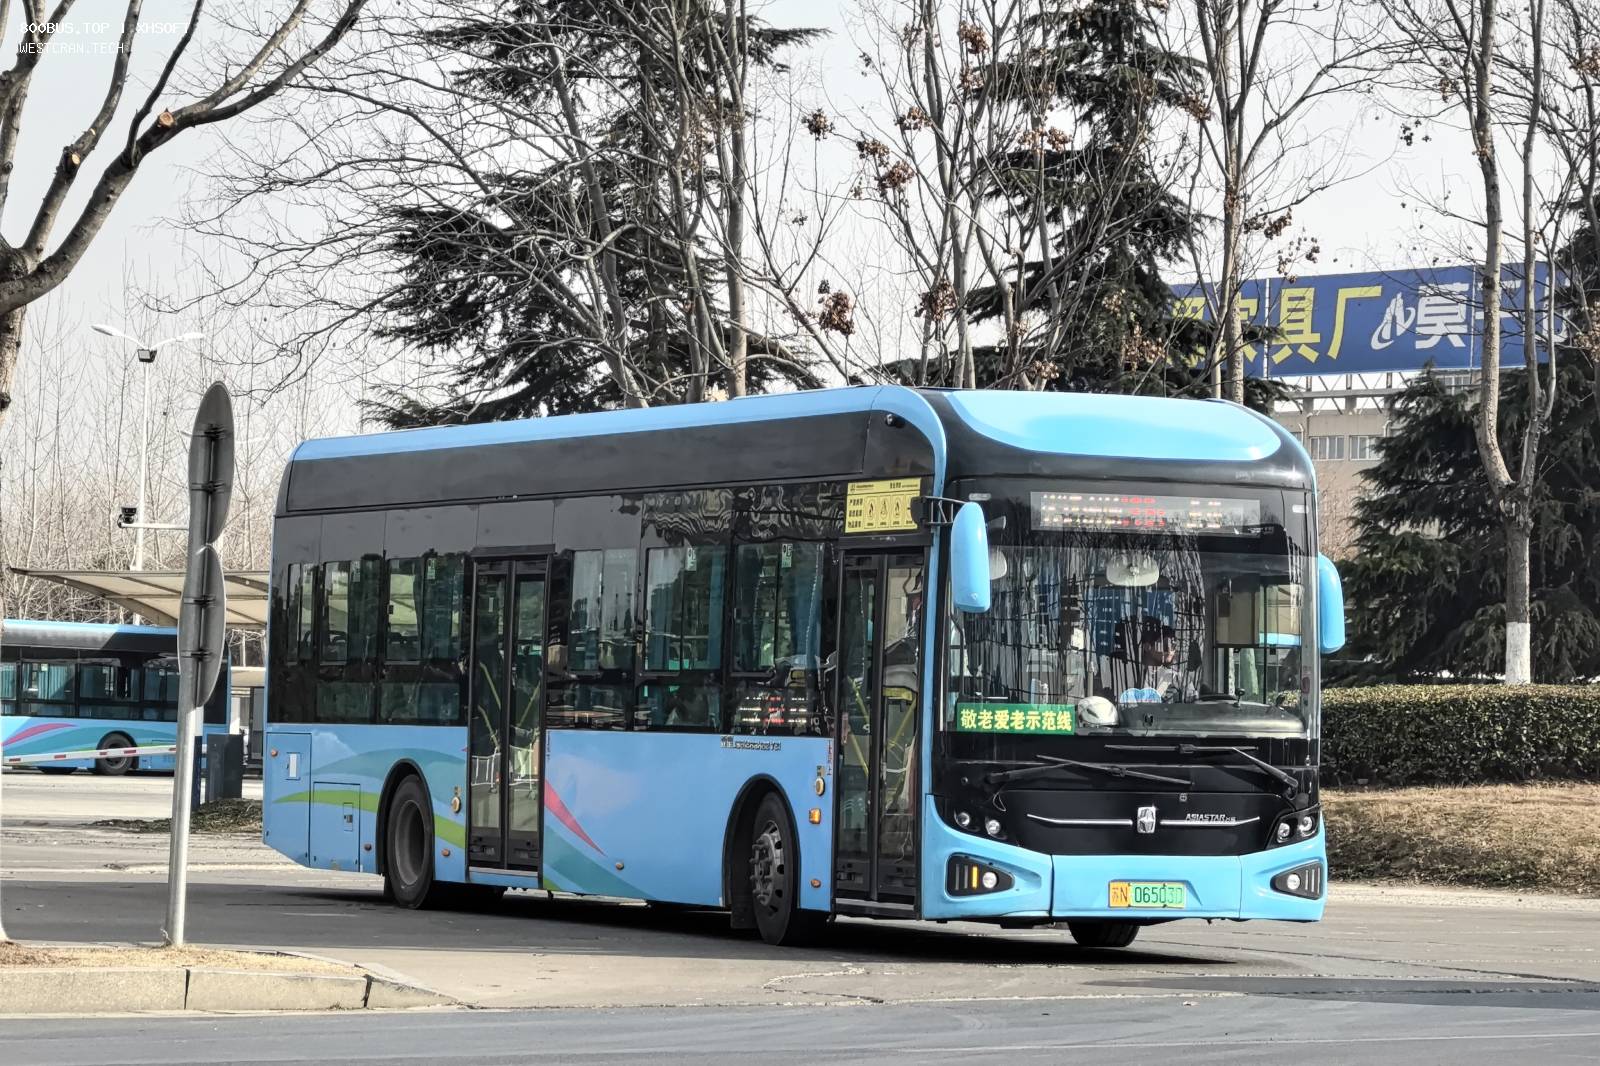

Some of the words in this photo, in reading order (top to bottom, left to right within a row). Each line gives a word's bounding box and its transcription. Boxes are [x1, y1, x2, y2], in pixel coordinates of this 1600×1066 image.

[960, 708, 1072, 731] 敬老爱老示范线
